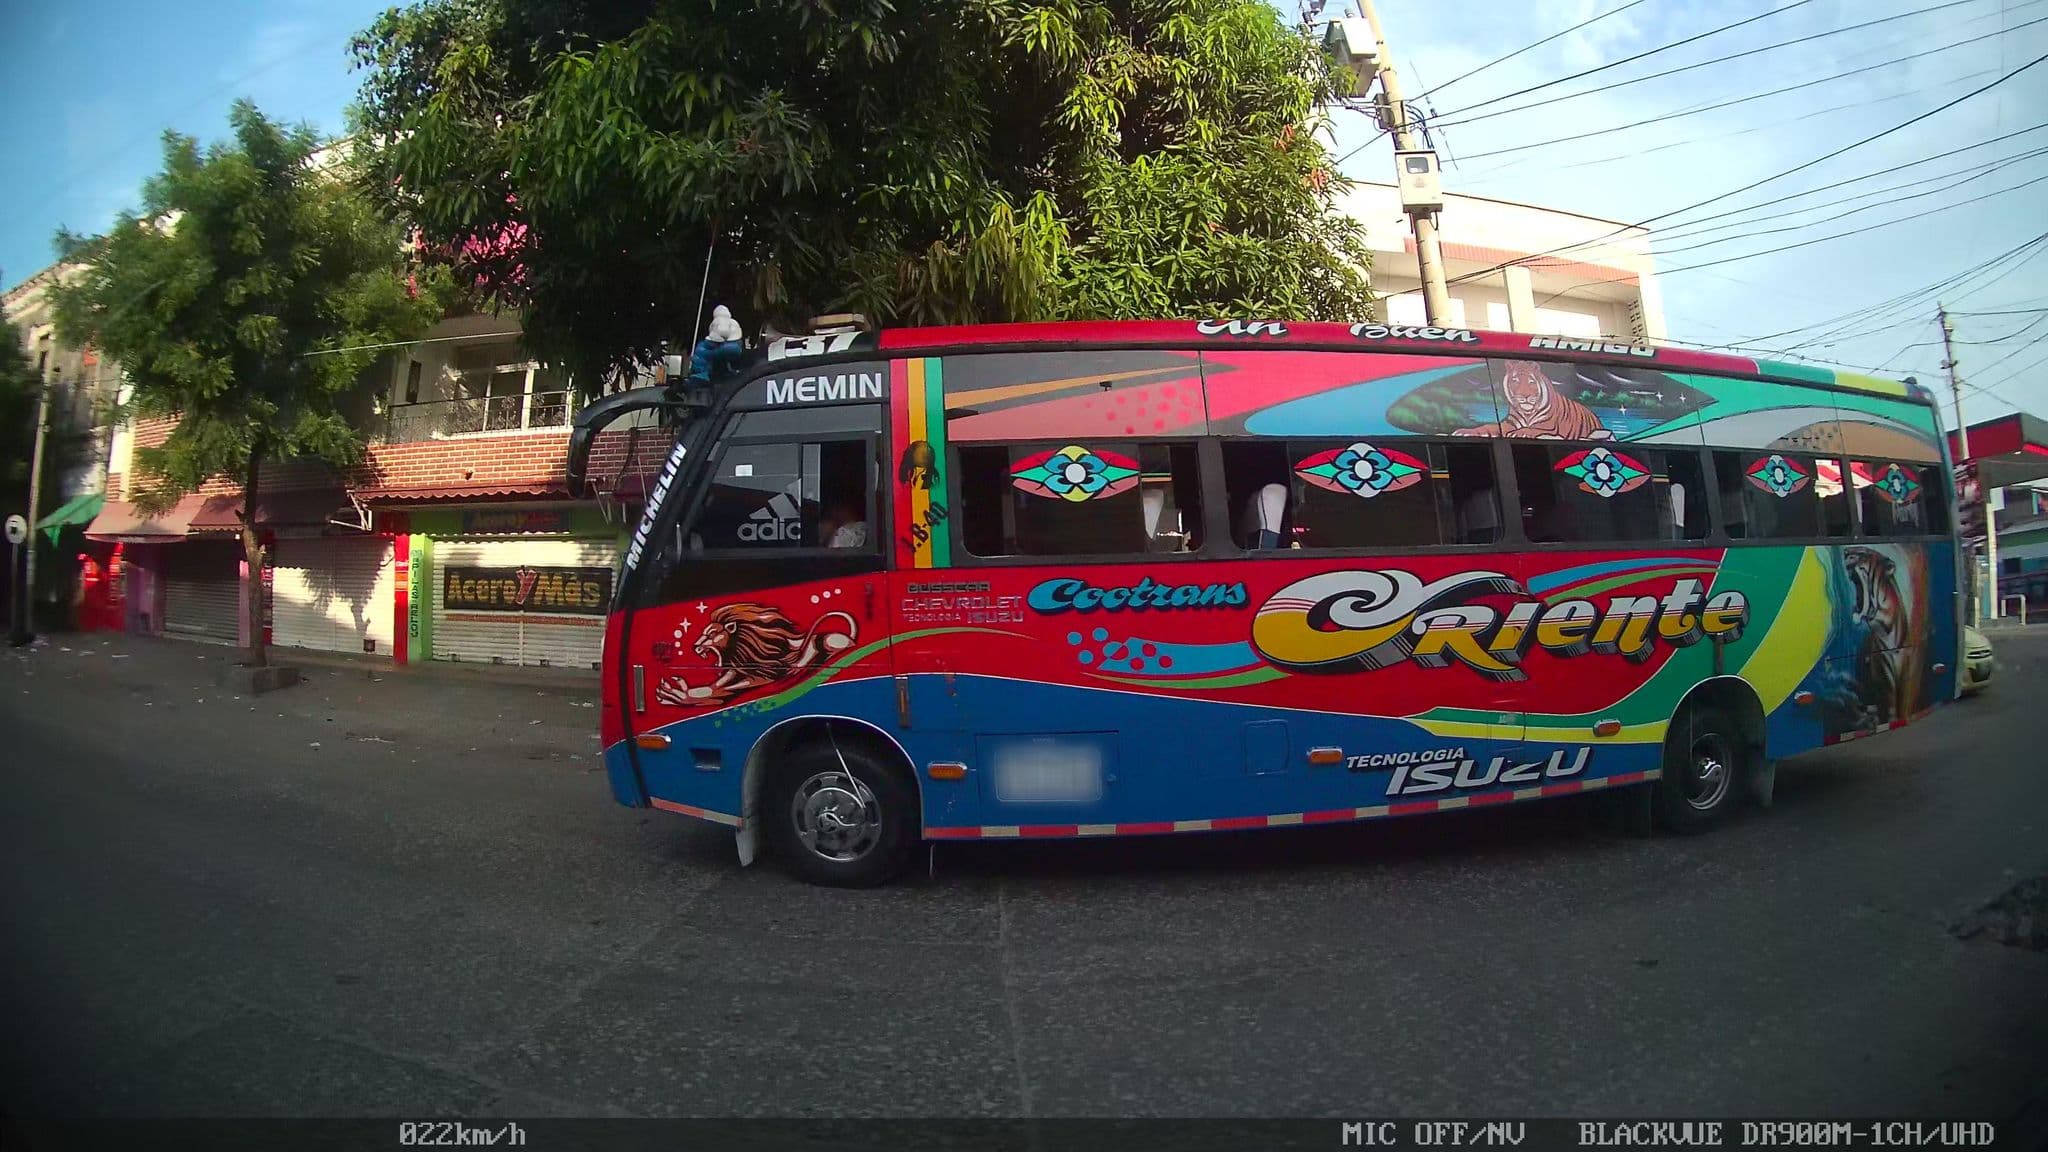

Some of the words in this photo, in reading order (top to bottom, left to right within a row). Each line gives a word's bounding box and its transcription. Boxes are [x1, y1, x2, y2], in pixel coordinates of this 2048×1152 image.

[768, 330, 863, 361] 137
[766, 372, 882, 404] MEMIN
[626, 440, 687, 571] MICHELIN
[902, 596, 1023, 611] CHEVROLET
[1027, 576, 1248, 613] Cootrans
[967, 610, 1024, 623] ISUZU
[1385, 746, 1591, 796] ISUZU
